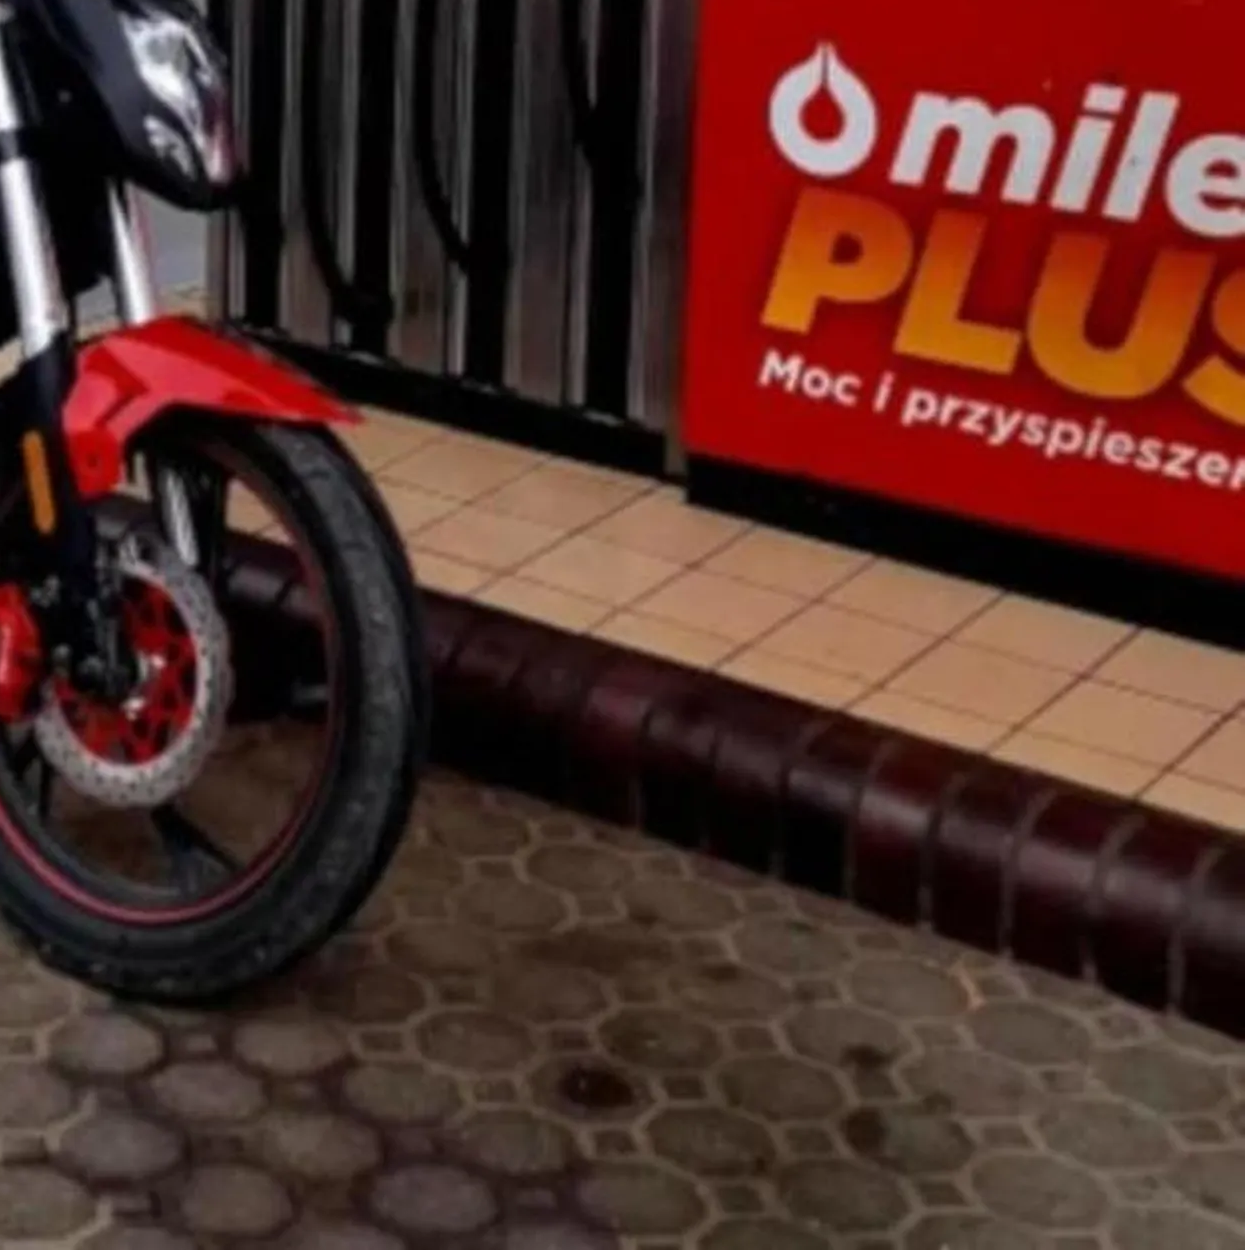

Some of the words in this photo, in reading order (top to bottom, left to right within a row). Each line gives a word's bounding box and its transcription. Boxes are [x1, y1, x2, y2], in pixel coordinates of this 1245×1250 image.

[889, 82, 1245, 238] mile
[757, 349, 863, 407] Moc
[872, 373, 896, 413] i
